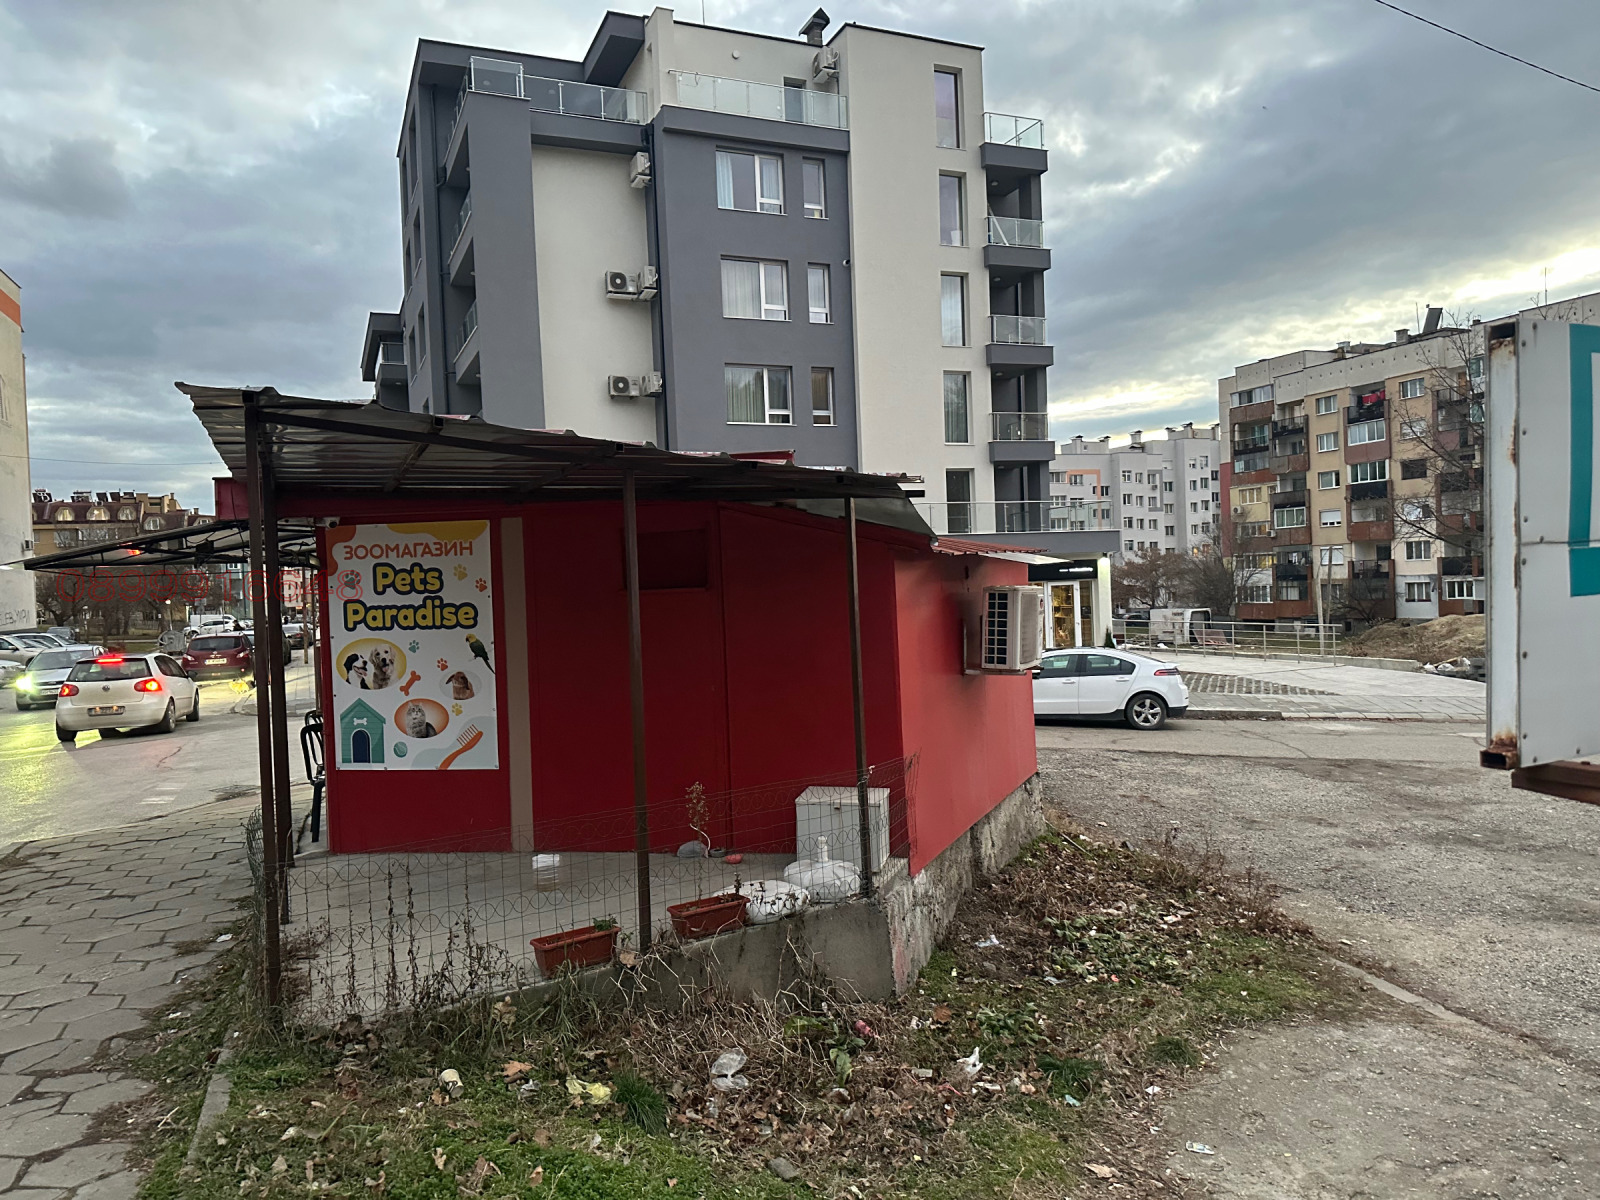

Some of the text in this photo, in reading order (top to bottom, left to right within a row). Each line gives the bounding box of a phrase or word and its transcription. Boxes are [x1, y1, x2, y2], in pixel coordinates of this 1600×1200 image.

[343, 541, 473, 560] ЗООМАГАЗИН
[374, 563, 443, 594] Pets
[344, 597, 477, 630] Paradise
